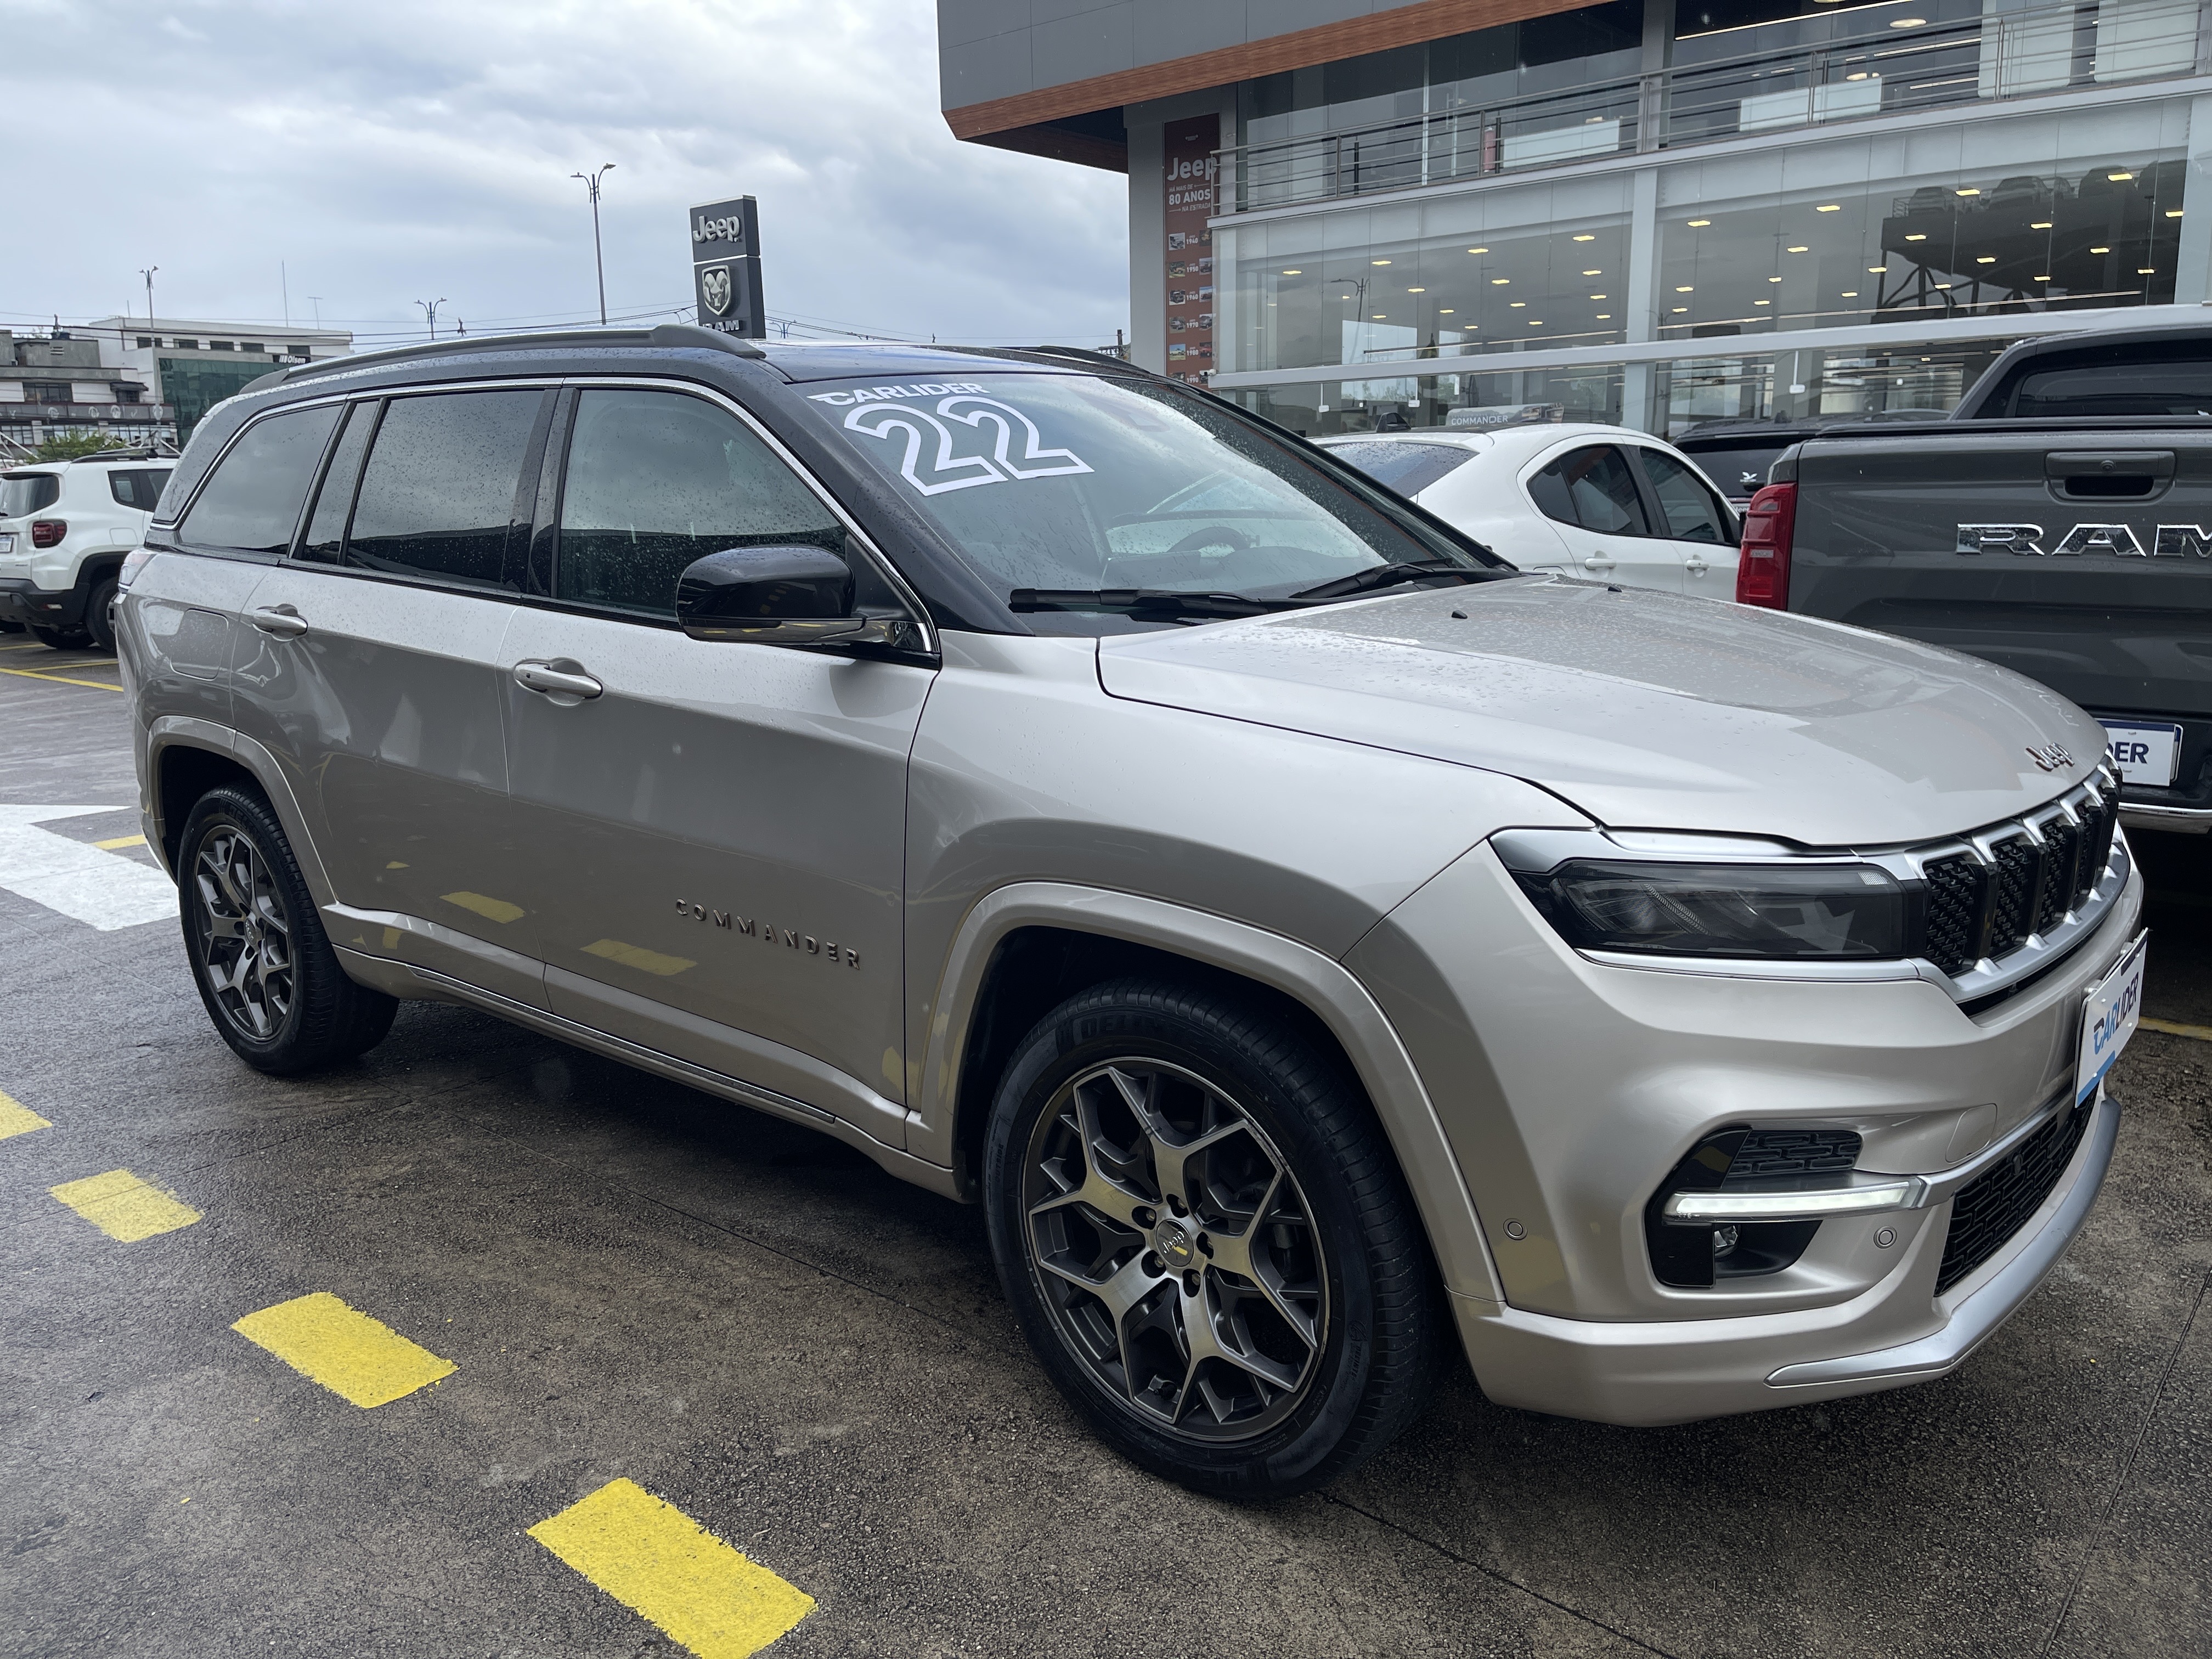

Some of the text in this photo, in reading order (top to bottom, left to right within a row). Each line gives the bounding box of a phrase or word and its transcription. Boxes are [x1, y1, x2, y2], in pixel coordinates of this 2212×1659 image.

[1167, 157, 1217, 181] Jeep
[1169, 188, 1211, 205] 80 ANOS
[1189, 202, 1211, 211] ESTRADA
[692, 215, 740, 243] Jeep
[806, 383, 990, 406] CARLIDER
[1451, 415, 1508, 425] COMMANDER
[844, 396, 1095, 496] 22
[1955, 523, 2212, 557] RAM
[2026, 742, 2074, 771] Jeep
[676, 898, 860, 970] COMMANDER
[2094, 972, 2139, 1055] CARLIDER
